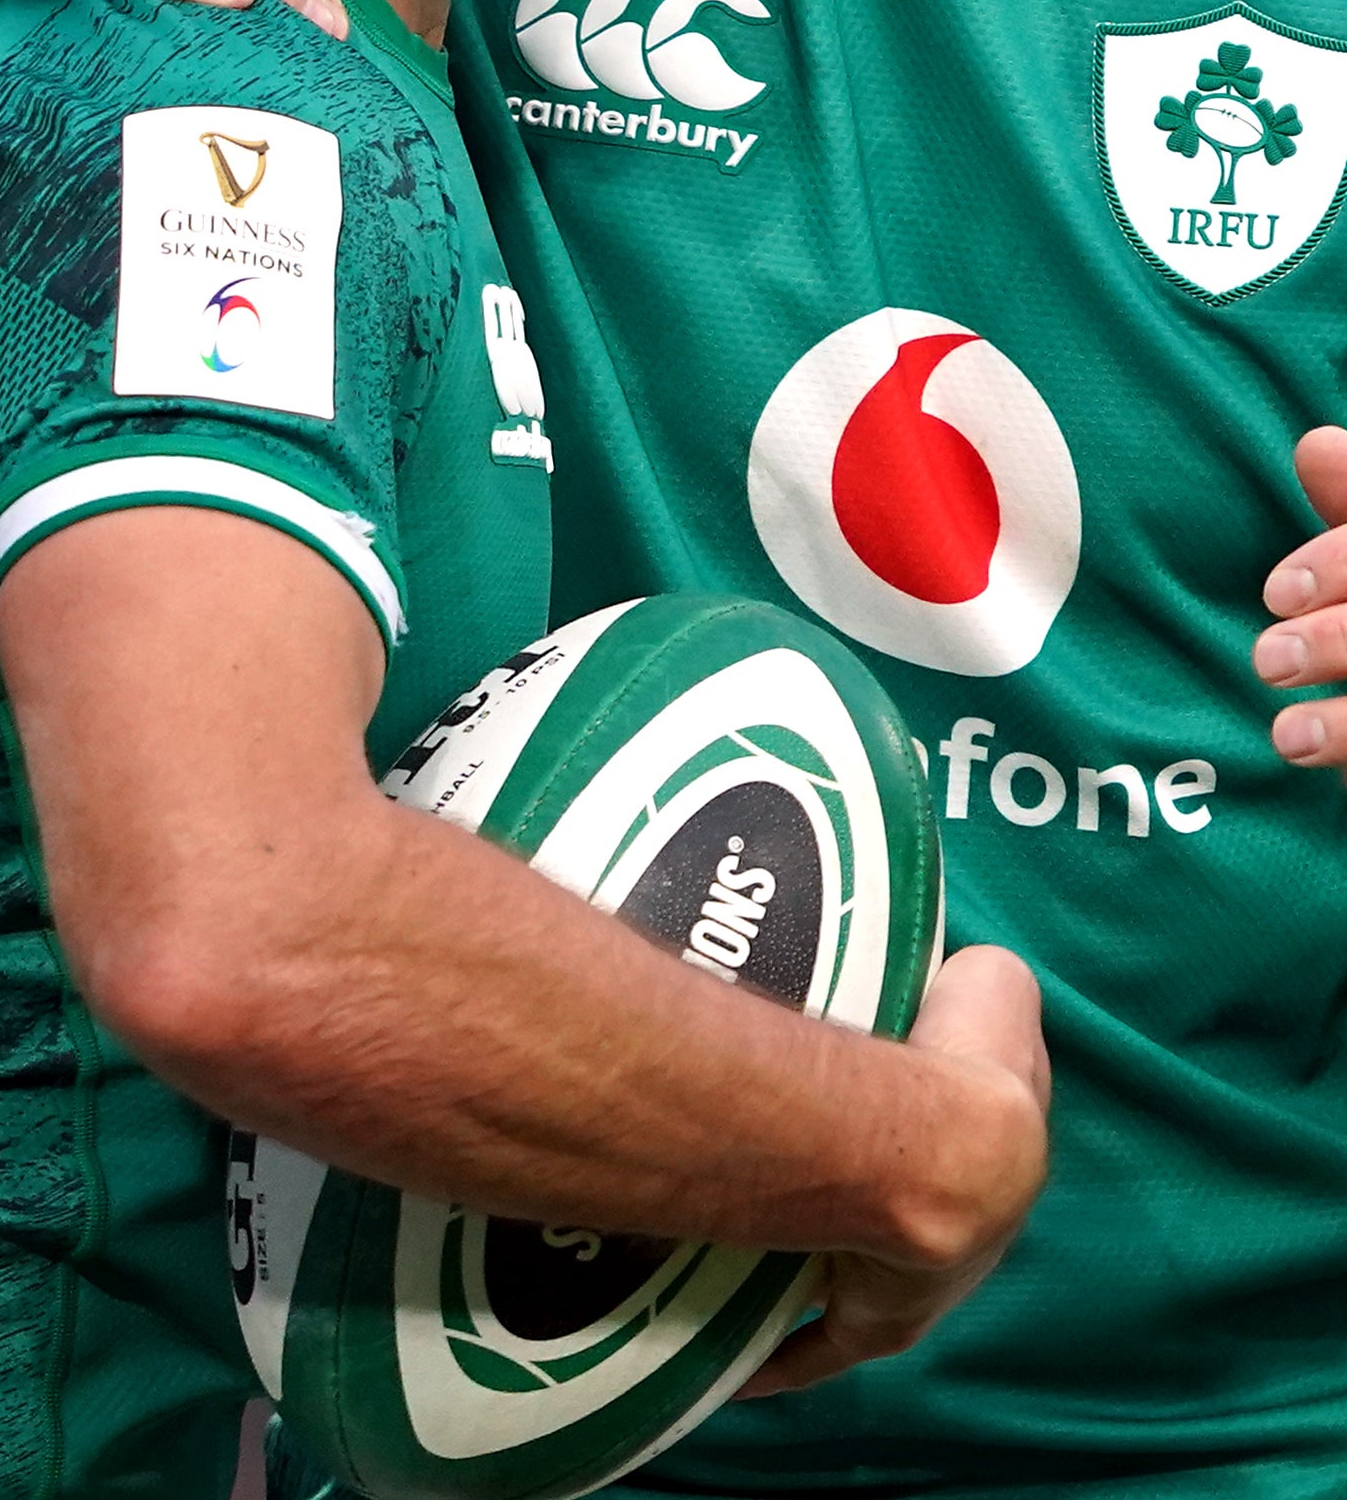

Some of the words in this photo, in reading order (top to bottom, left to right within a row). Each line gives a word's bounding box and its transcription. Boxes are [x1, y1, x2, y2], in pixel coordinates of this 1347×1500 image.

[160, 209, 305, 252] GUINNESS
[1167, 207, 1279, 250] IRFU
[161, 242, 195, 257] SIX
[205, 245, 303, 278] NATIONS
[911, 716, 1217, 838] fone
